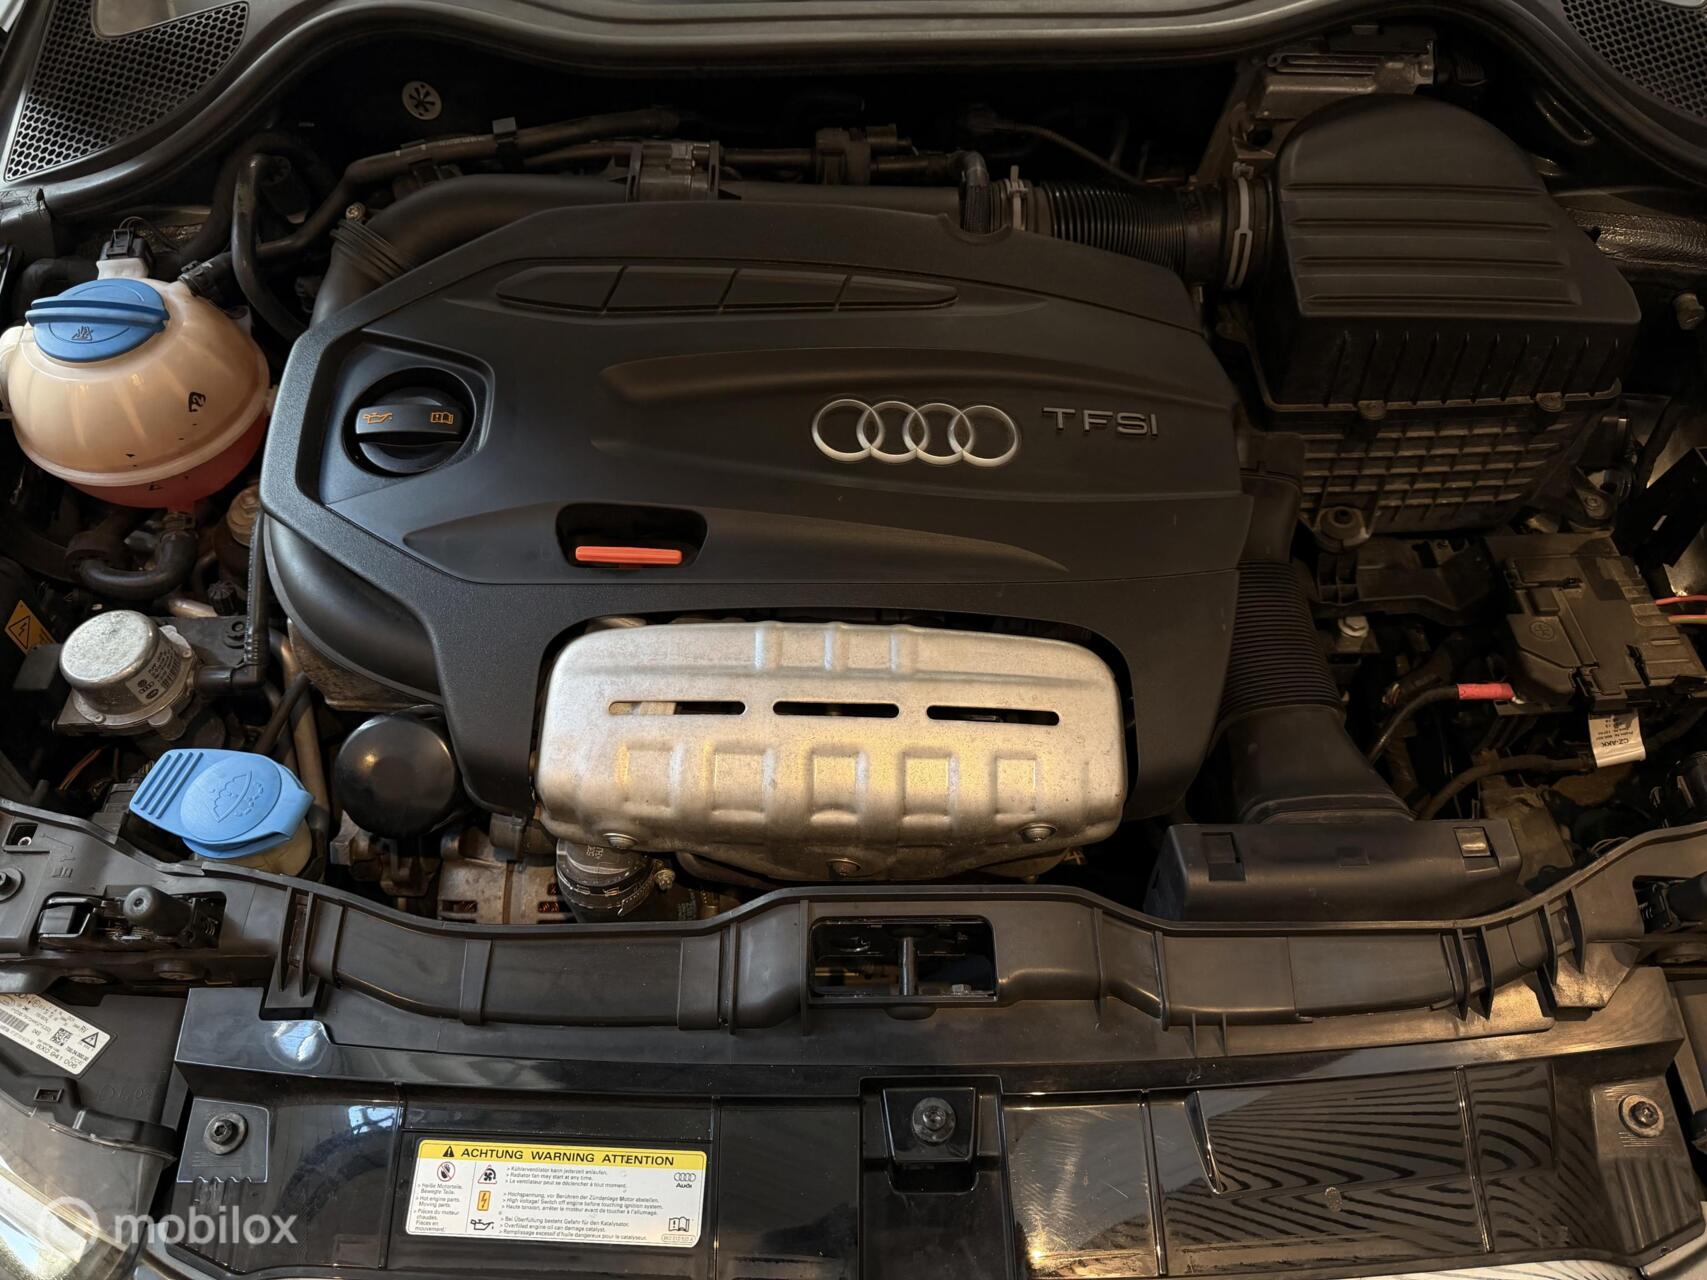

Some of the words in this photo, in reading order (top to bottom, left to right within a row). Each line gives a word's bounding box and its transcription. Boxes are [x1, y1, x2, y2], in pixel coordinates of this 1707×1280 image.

[1041, 406, 1159, 438] TFSI
[461, 1148, 524, 1160] ACHTUNG
[531, 1151, 595, 1163] WARNING
[602, 1154, 674, 1166] ATTENTION
